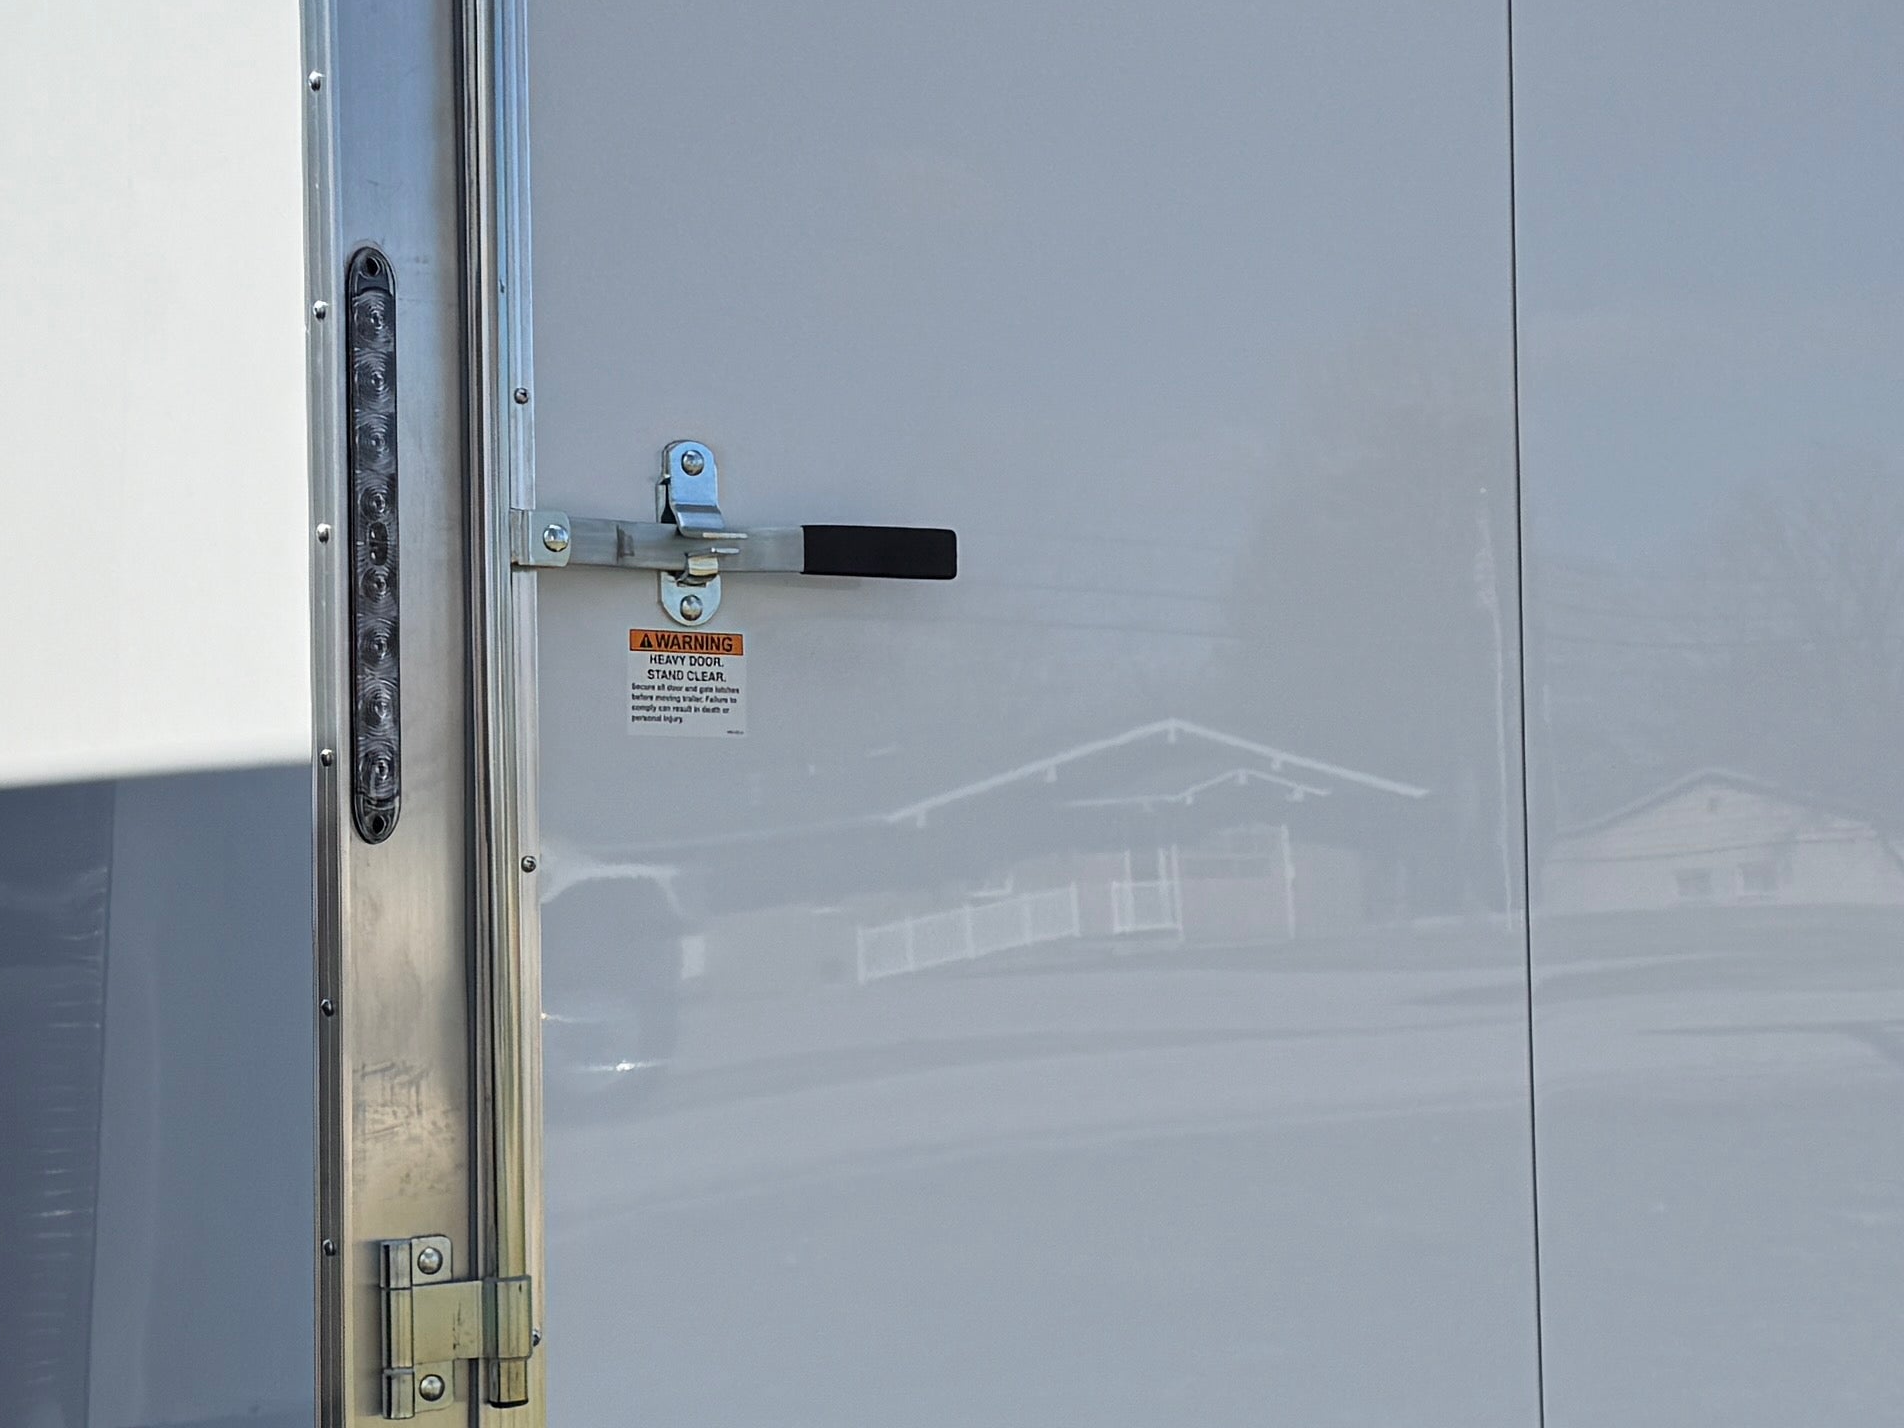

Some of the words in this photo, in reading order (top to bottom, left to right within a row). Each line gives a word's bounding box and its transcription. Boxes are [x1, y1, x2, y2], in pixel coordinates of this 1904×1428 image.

[656, 633, 733, 652] WARNING
[649, 654, 686, 666] HEAVY
[689, 656, 724, 667] DOOR.
[647, 669, 684, 680] STAND
[686, 670, 726, 682] CLEAR.
